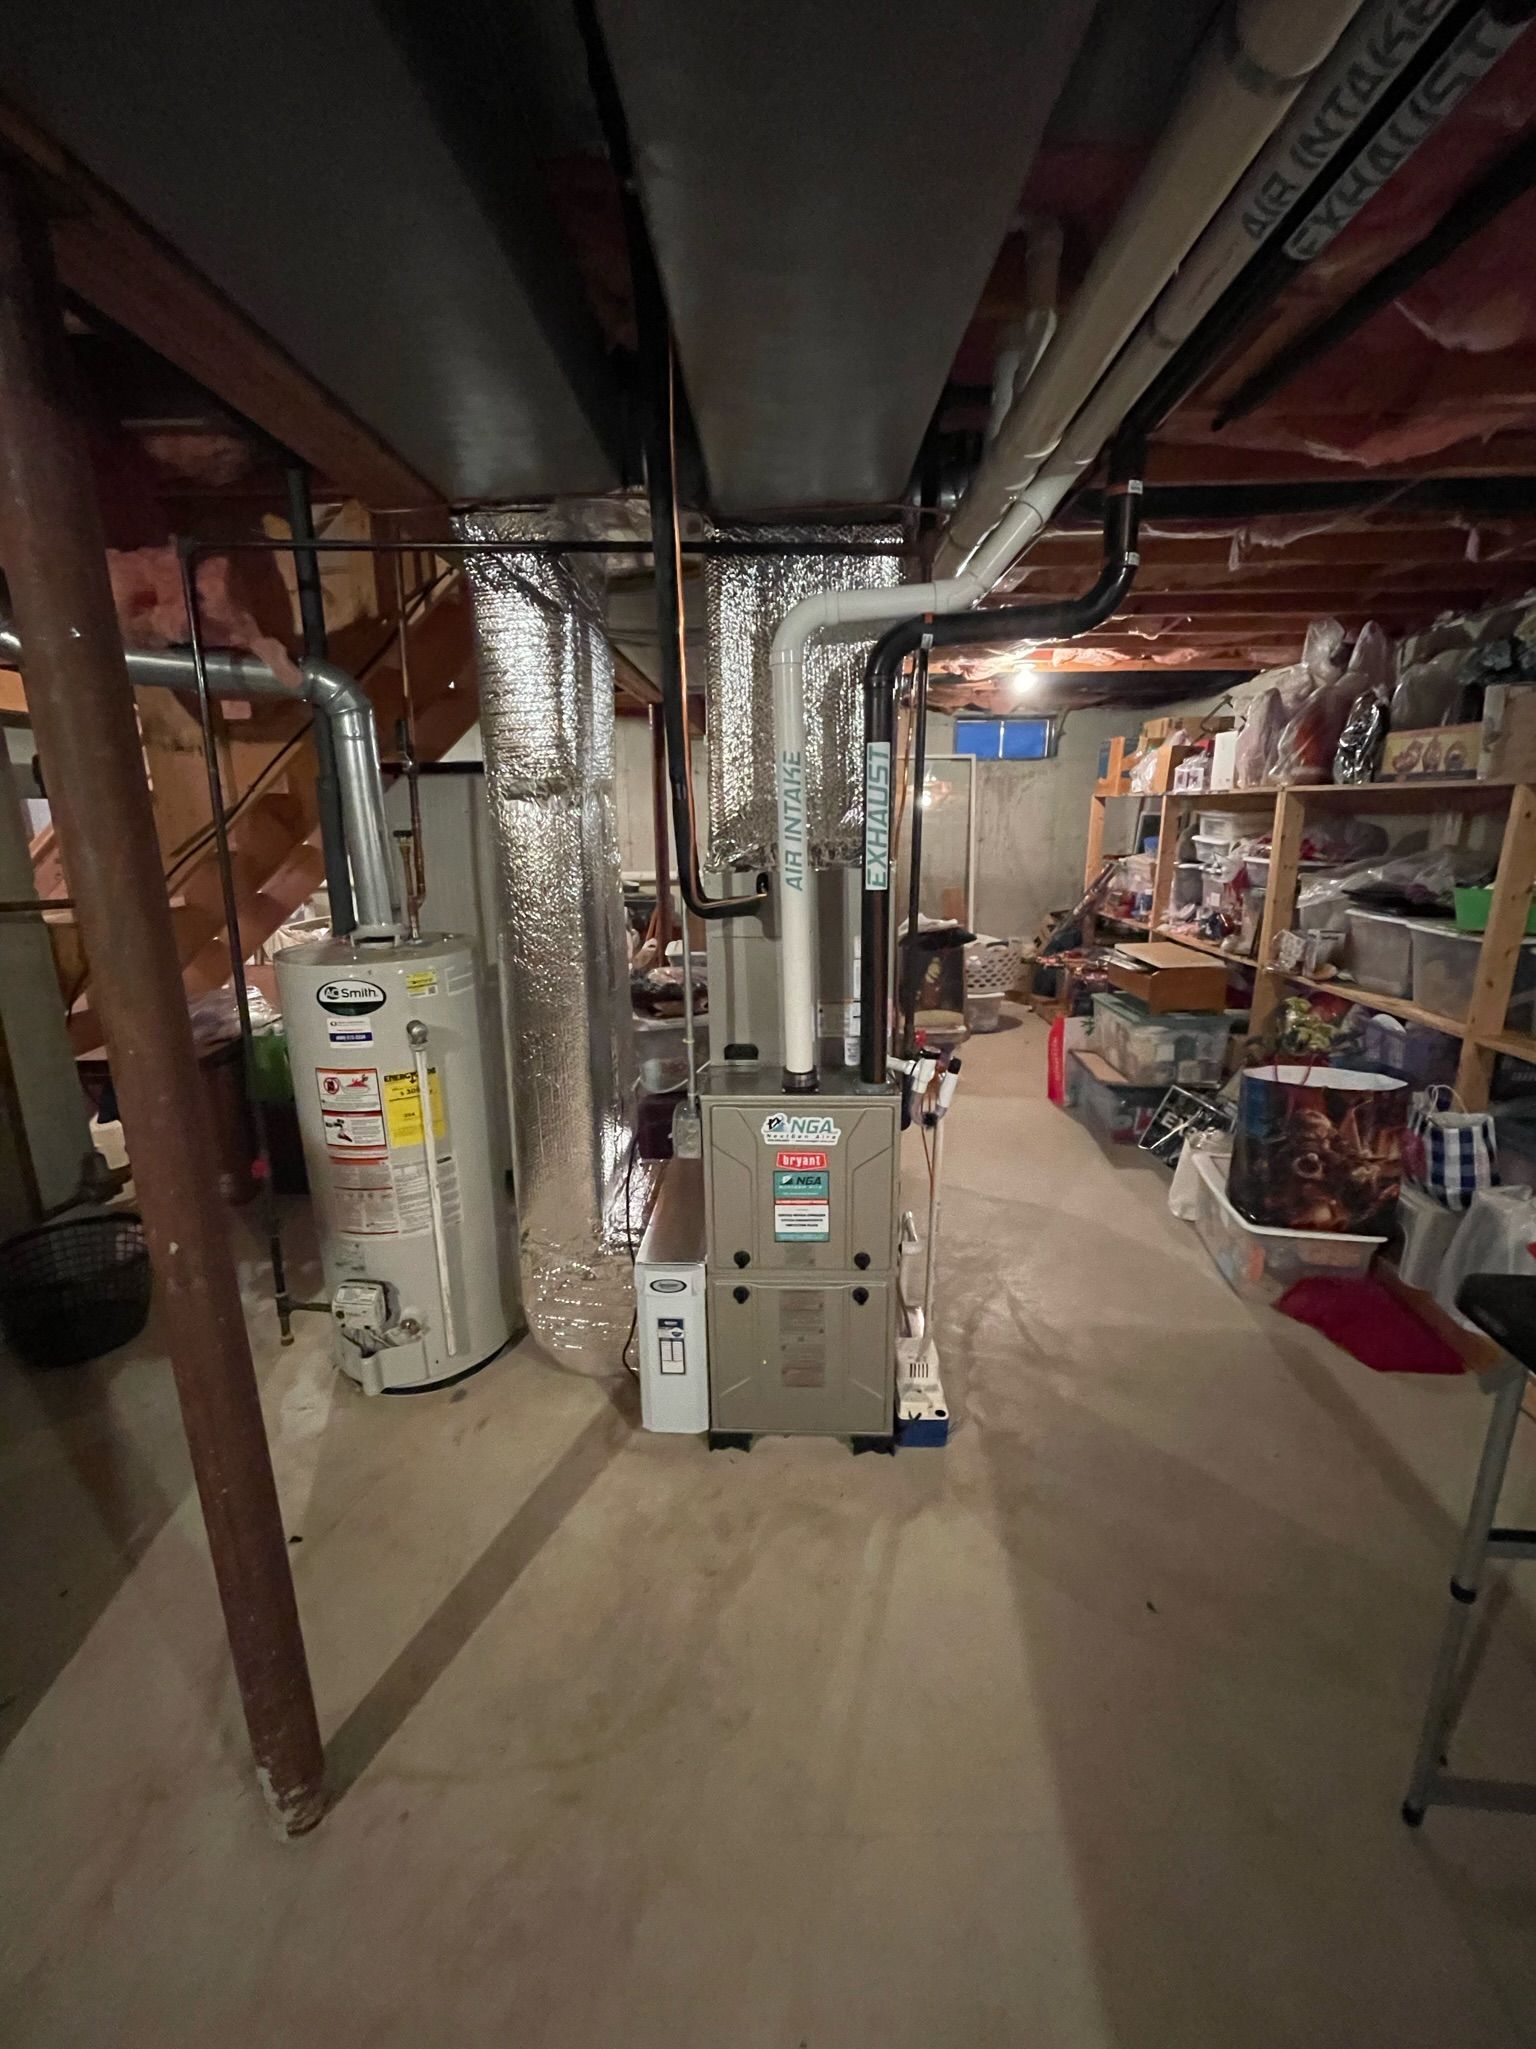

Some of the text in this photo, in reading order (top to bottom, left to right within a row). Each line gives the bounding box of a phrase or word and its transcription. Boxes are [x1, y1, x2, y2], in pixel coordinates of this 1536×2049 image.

[1291, 8, 1498, 258] EXHAUST
[1241, 170, 1298, 241] AIR
[783, 750, 803, 891] AIR INTAKE
[867, 744, 889, 888] EXHAUST
[341, 987, 377, 998] Smith
[791, 1119, 832, 1134] NGA
[782, 1155, 821, 1167] bryant
[796, 1176, 822, 1185] NGA
